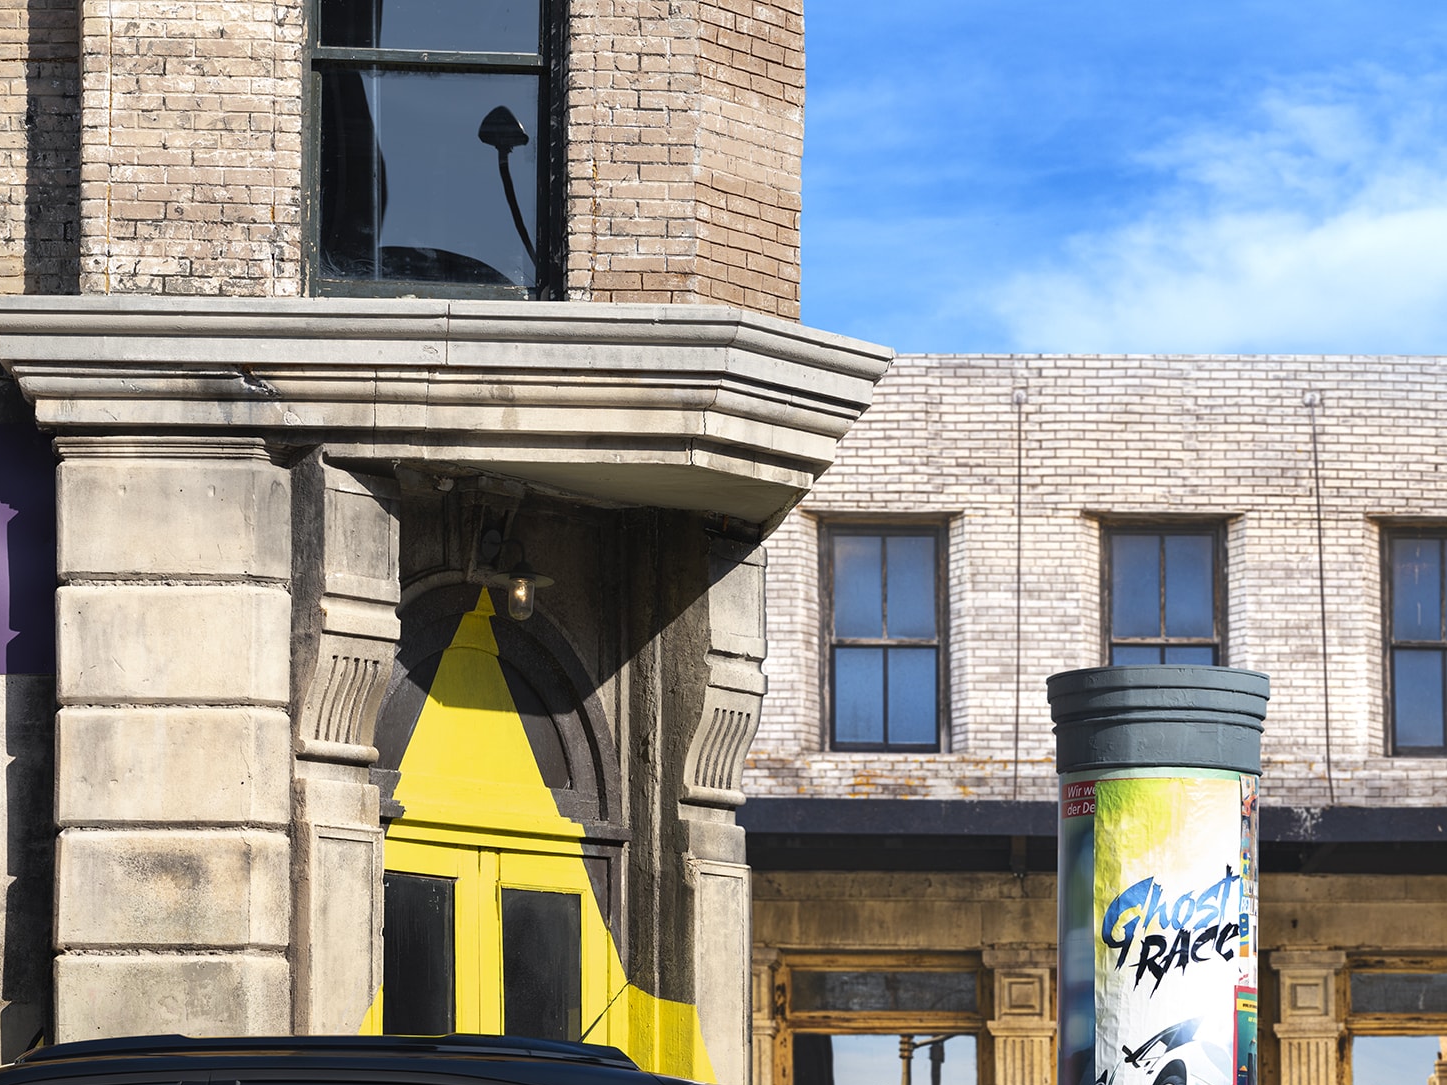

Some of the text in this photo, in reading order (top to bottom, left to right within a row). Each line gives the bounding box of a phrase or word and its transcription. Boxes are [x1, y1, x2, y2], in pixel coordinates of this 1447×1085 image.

[1067, 785, 1082, 798] Wir
[1067, 803, 1081, 815] der
[1102, 863, 1240, 972] Ghost
